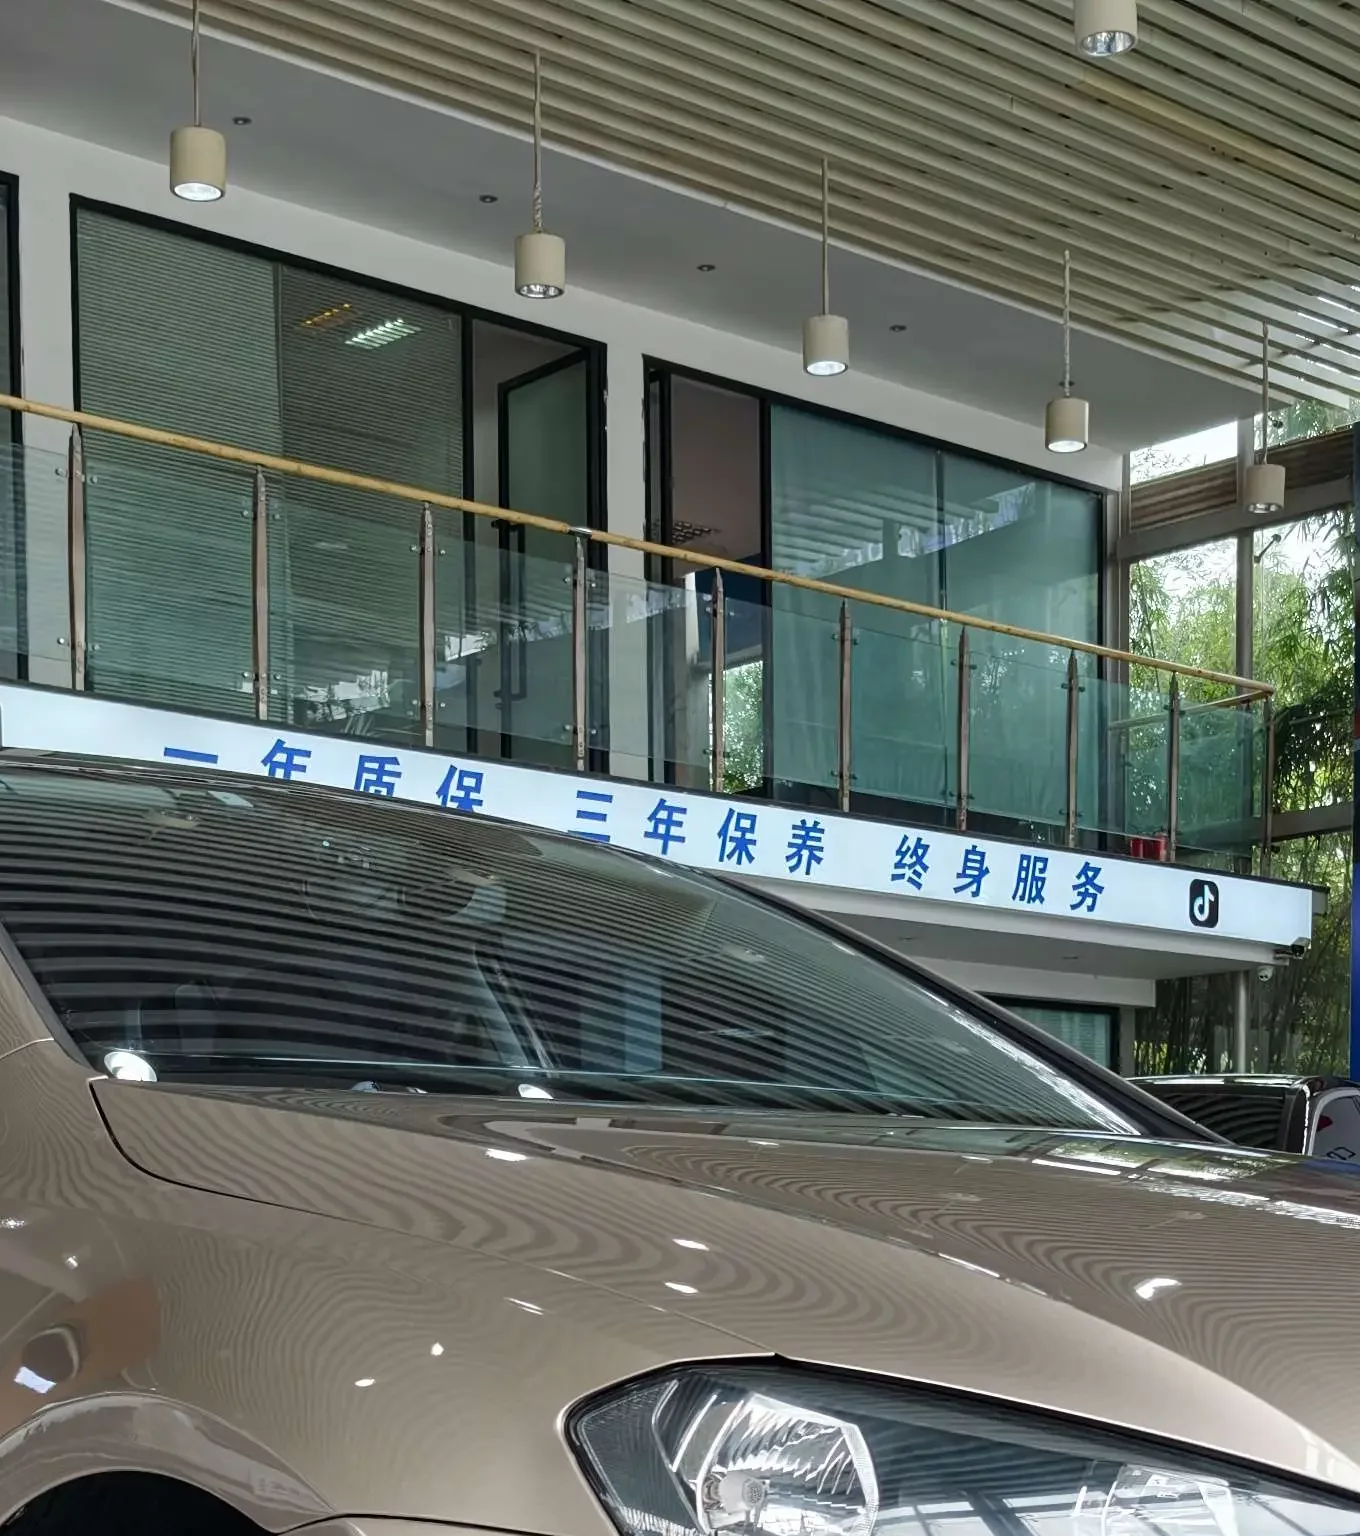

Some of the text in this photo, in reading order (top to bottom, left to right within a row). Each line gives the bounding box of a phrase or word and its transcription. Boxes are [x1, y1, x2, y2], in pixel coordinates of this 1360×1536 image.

[163, 738, 1106, 914] 一年质保 三年保养 终身服务
